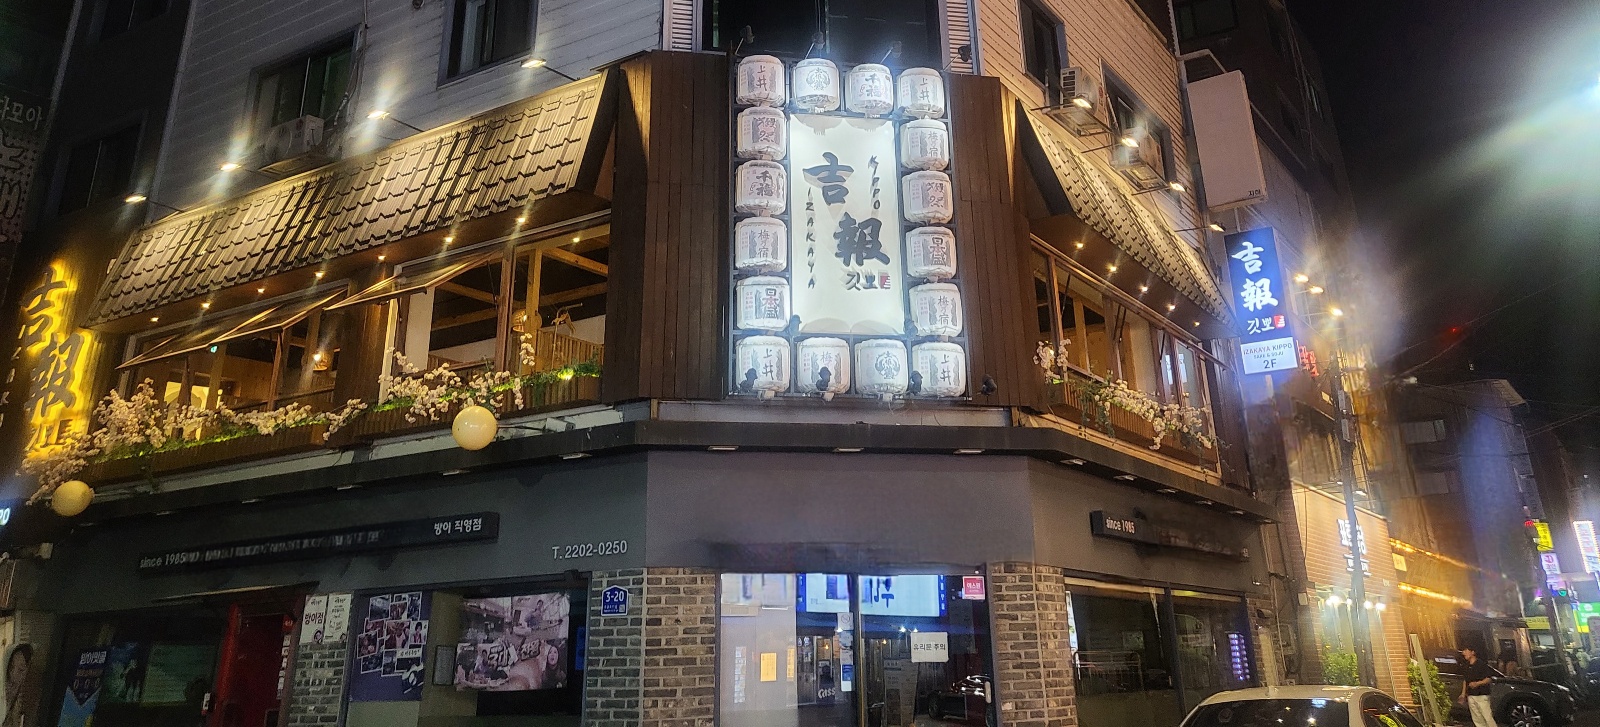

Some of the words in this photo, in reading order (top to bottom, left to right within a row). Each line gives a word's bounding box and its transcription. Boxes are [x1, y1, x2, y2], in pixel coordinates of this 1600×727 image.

[805, 187, 816, 289] IZAKAYA
[1272, 342, 1293, 351] KIPPO
[1263, 358, 1277, 369] 2F
[433, 520, 452, 536] 방이
[454, 518, 483, 534] 직영점
[1106, 516, 1122, 532] since
[140, 556, 163, 569] since
[605, 591, 624, 603] 3-20
[304, 611, 325, 626] 방이점
[934, 642, 946, 651] 주의
[817, 686, 836, 700] Cass
